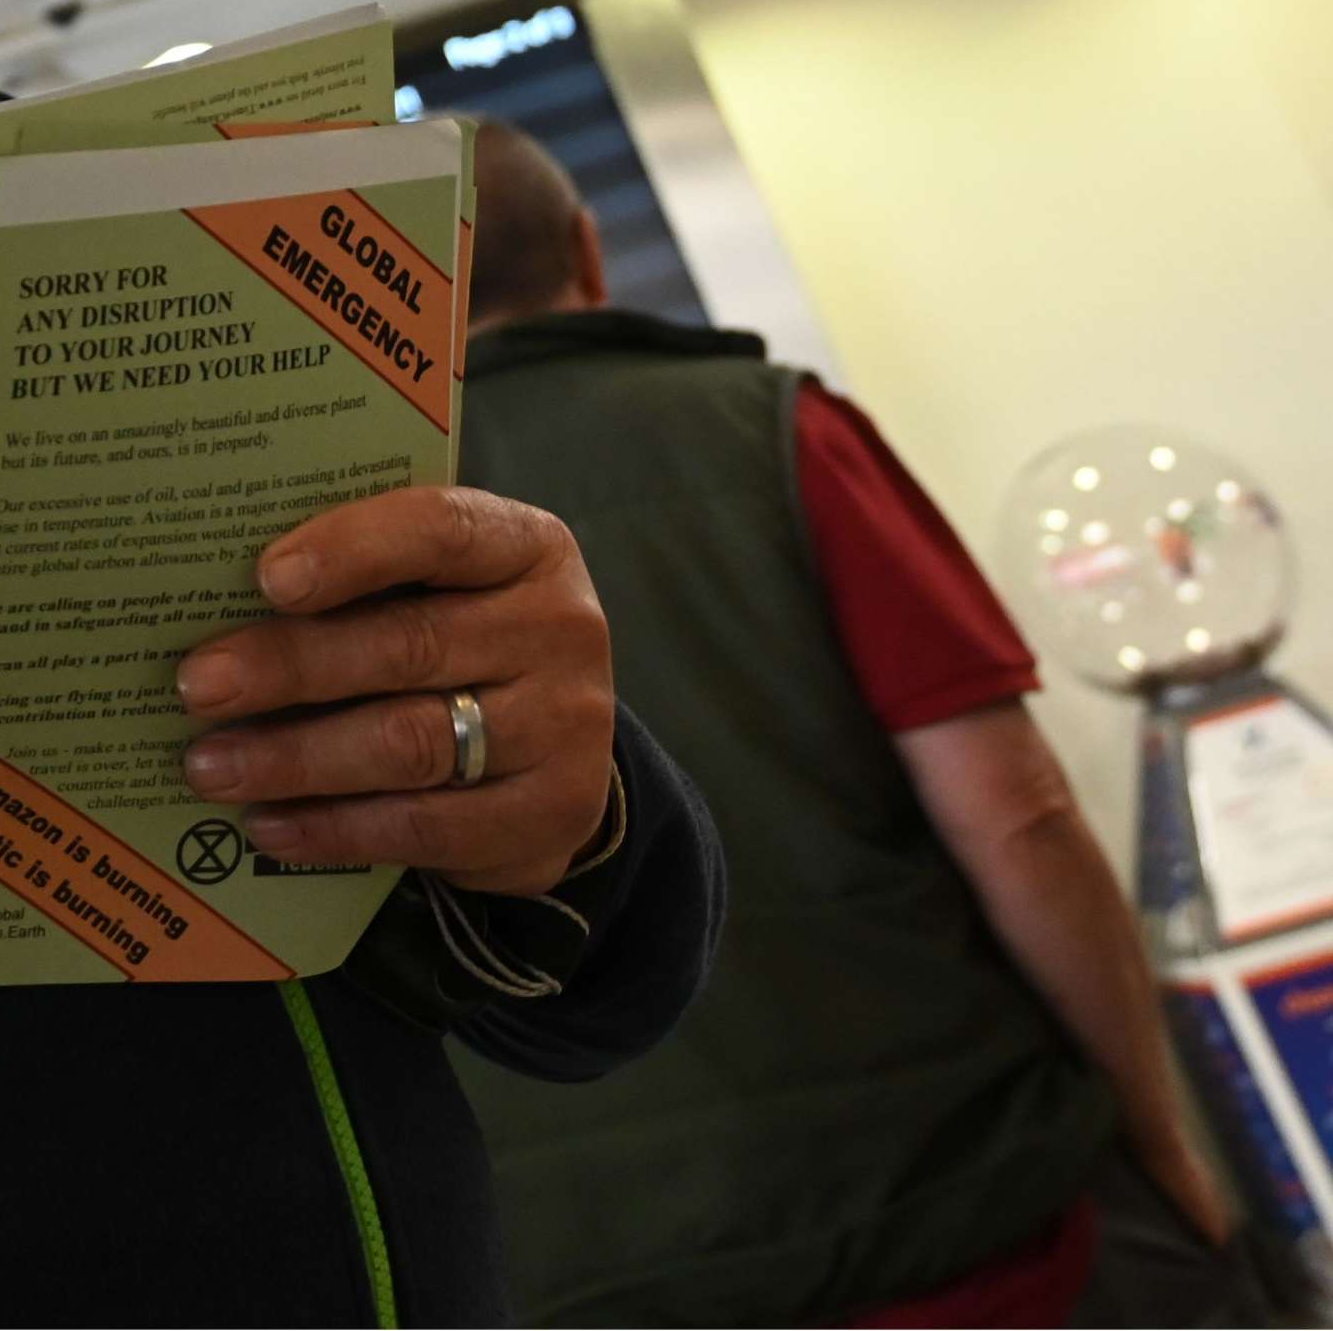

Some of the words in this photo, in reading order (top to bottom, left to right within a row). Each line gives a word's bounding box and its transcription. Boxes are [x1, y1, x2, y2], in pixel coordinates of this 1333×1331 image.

[320, 205, 422, 315] GLOBAL
[16, 268, 109, 301] SORRY
[115, 262, 168, 291] FOR
[14, 307, 74, 336] ANY
[79, 289, 235, 328] DISRUPTION
[262, 224, 434, 382] EMERGENCY
[12, 341, 53, 368] TO
[59, 333, 135, 364] YOUR
[137, 319, 257, 356] JOURNEY
[10, 372, 68, 402] BUT
[71, 368, 117, 397] WE
[118, 360, 192, 391] NEED
[195, 351, 268, 383] YOUR
[270, 341, 333, 372] HELP
[3, 430, 32, 450] We
[33, 427, 65, 447] live
[67, 429, 89, 445] on
[90, 428, 110, 443] an
[112, 414, 189, 446] amazingly
[190, 408, 253, 435] beautiful
[254, 406, 281, 425] and
[281, 397, 329, 421] diverse
[329, 391, 370, 414] planet
[0, 452, 27, 472] but
[28, 451, 50, 469] its
[50, 443, 102, 471] future,
[104, 442, 136, 463] and
[176, 441, 191, 456] is
[192, 439, 210, 454] in
[209, 426, 277, 457] jeopardy.
[27, 489, 101, 515] excessive
[104, 489, 131, 507] use
[132, 485, 154, 504] of
[154, 484, 177, 503] oil,
[181, 481, 213, 502] coal
[214, 478, 242, 497] and
[243, 476, 271, 496] gas
[273, 473, 284, 489] is
[285, 467, 337, 490] causing
[346, 449, 415, 478] devastating
[22, 519, 39, 534] in
[143, 502, 205, 528] Aviation
[208, 503, 223, 520] is
[225, 505, 235, 518] a
[236, 497, 278, 522] major
[278, 485, 354, 513] contributor
[354, 482, 370, 499] to
[368, 475, 392, 496] this
[4, 539, 61, 560] current
[64, 536, 100, 554] rates
[101, 532, 121, 551] of
[122, 528, 199, 555] expansion
[199, 523, 245, 545] would
[29, 555, 81, 579] global
[82, 552, 135, 573] carbon
[138, 545, 215, 571] allowance
[217, 545, 239, 564] by
[6, 600, 35, 614] are
[38, 593, 92, 616] calling
[95, 595, 116, 610] on
[120, 589, 174, 610] people
[178, 589, 196, 605] of
[197, 587, 222, 603] the
[226, 586, 264, 602] wor
[33, 618, 50, 633] in
[54, 607, 158, 637] safeguarding
[162, 607, 183, 624] all
[186, 607, 214, 623] our
[27, 655, 49, 671] all
[50, 652, 86, 672] play
[90, 654, 101, 664] a
[104, 651, 139, 667] part
[143, 648, 159, 662] in
[33, 693, 63, 705] our
[66, 686, 113, 706] flying
[116, 688, 131, 700] to
[134, 684, 167, 699] just
[100, 706, 118, 719] to
[120, 701, 189, 721] reducing
[5, 745, 37, 760] Join
[41, 747, 58, 758] us
[73, 741, 114, 755] make
[117, 743, 127, 753] a
[129, 736, 182, 755] change
[27, 761, 71, 777] travel
[75, 761, 88, 773] is
[92, 760, 129, 774] over,
[134, 756, 153, 770] let
[156, 758, 173, 769] us
[55, 777, 123, 794] countries
[128, 775, 157, 789] and
[159, 773, 187, 787] bui
[86, 792, 165, 813] challenges
[168, 791, 198, 806] ahe
[64, 835, 92, 864] is
[91, 855, 190, 941] burning
[25, 860, 51, 888] is
[52, 880, 150, 965] burning
